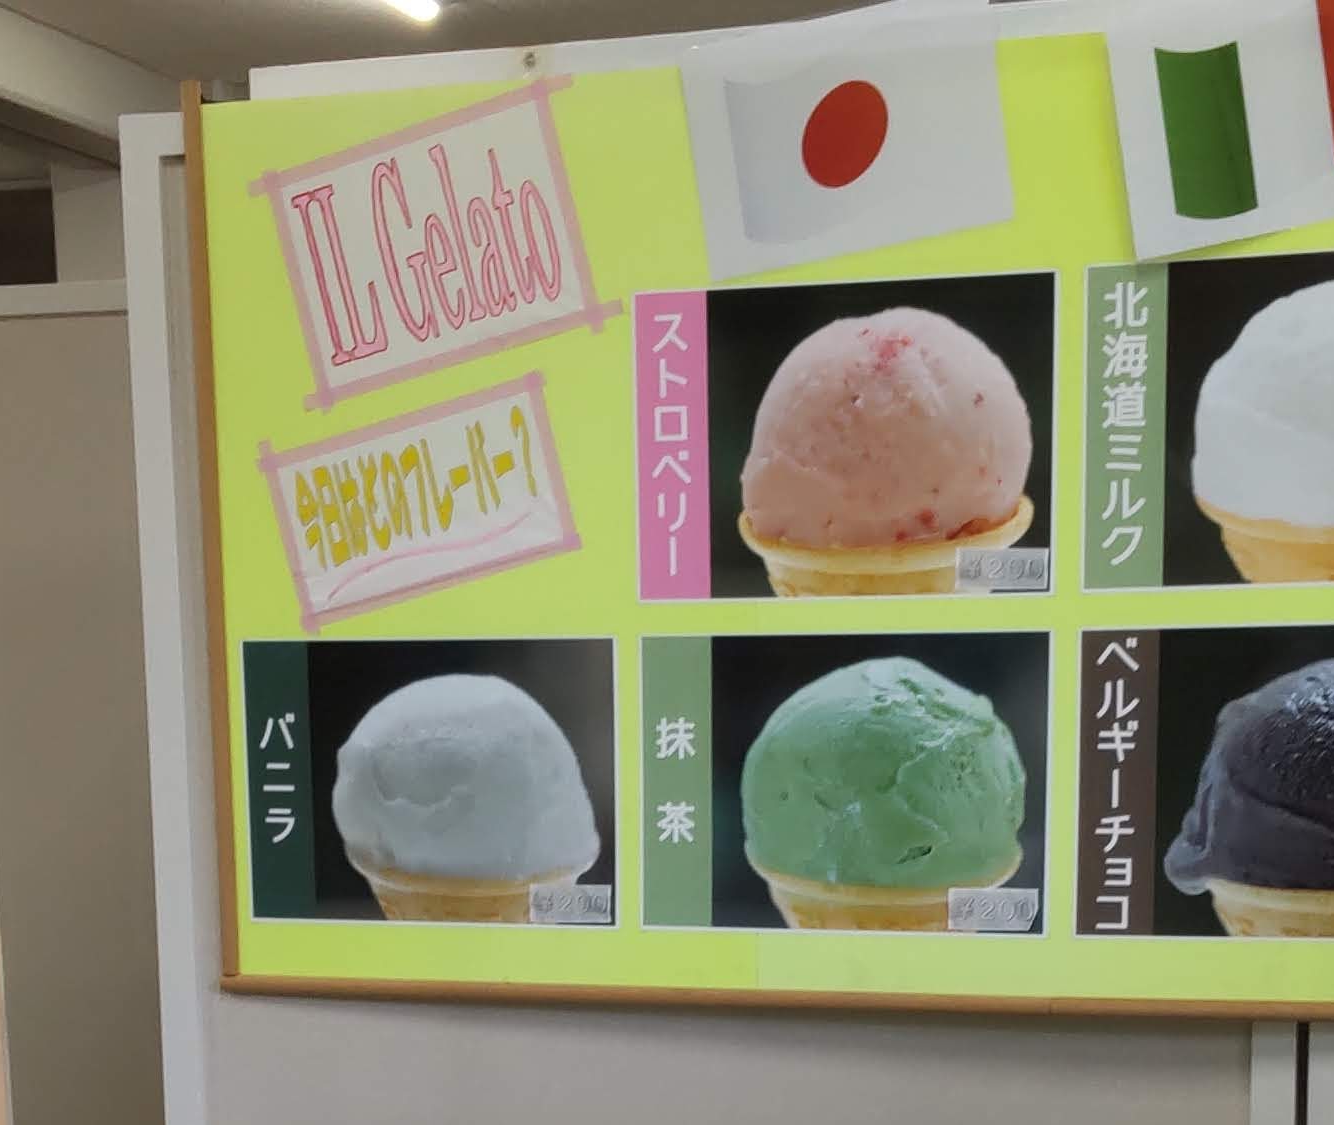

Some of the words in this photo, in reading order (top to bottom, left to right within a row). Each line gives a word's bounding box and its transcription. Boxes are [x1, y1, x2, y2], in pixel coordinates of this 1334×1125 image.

[292, 184, 389, 367] IL
[371, 143, 561, 342] Gelato
[651, 312, 692, 578] ストロベリー
[1101, 281, 1149, 567] 北海道ミルク
[258, 712, 297, 845] バニラ
[654, 715, 697, 844] 抹茶
[1093, 635, 1140, 932] ベルギーチョコ
